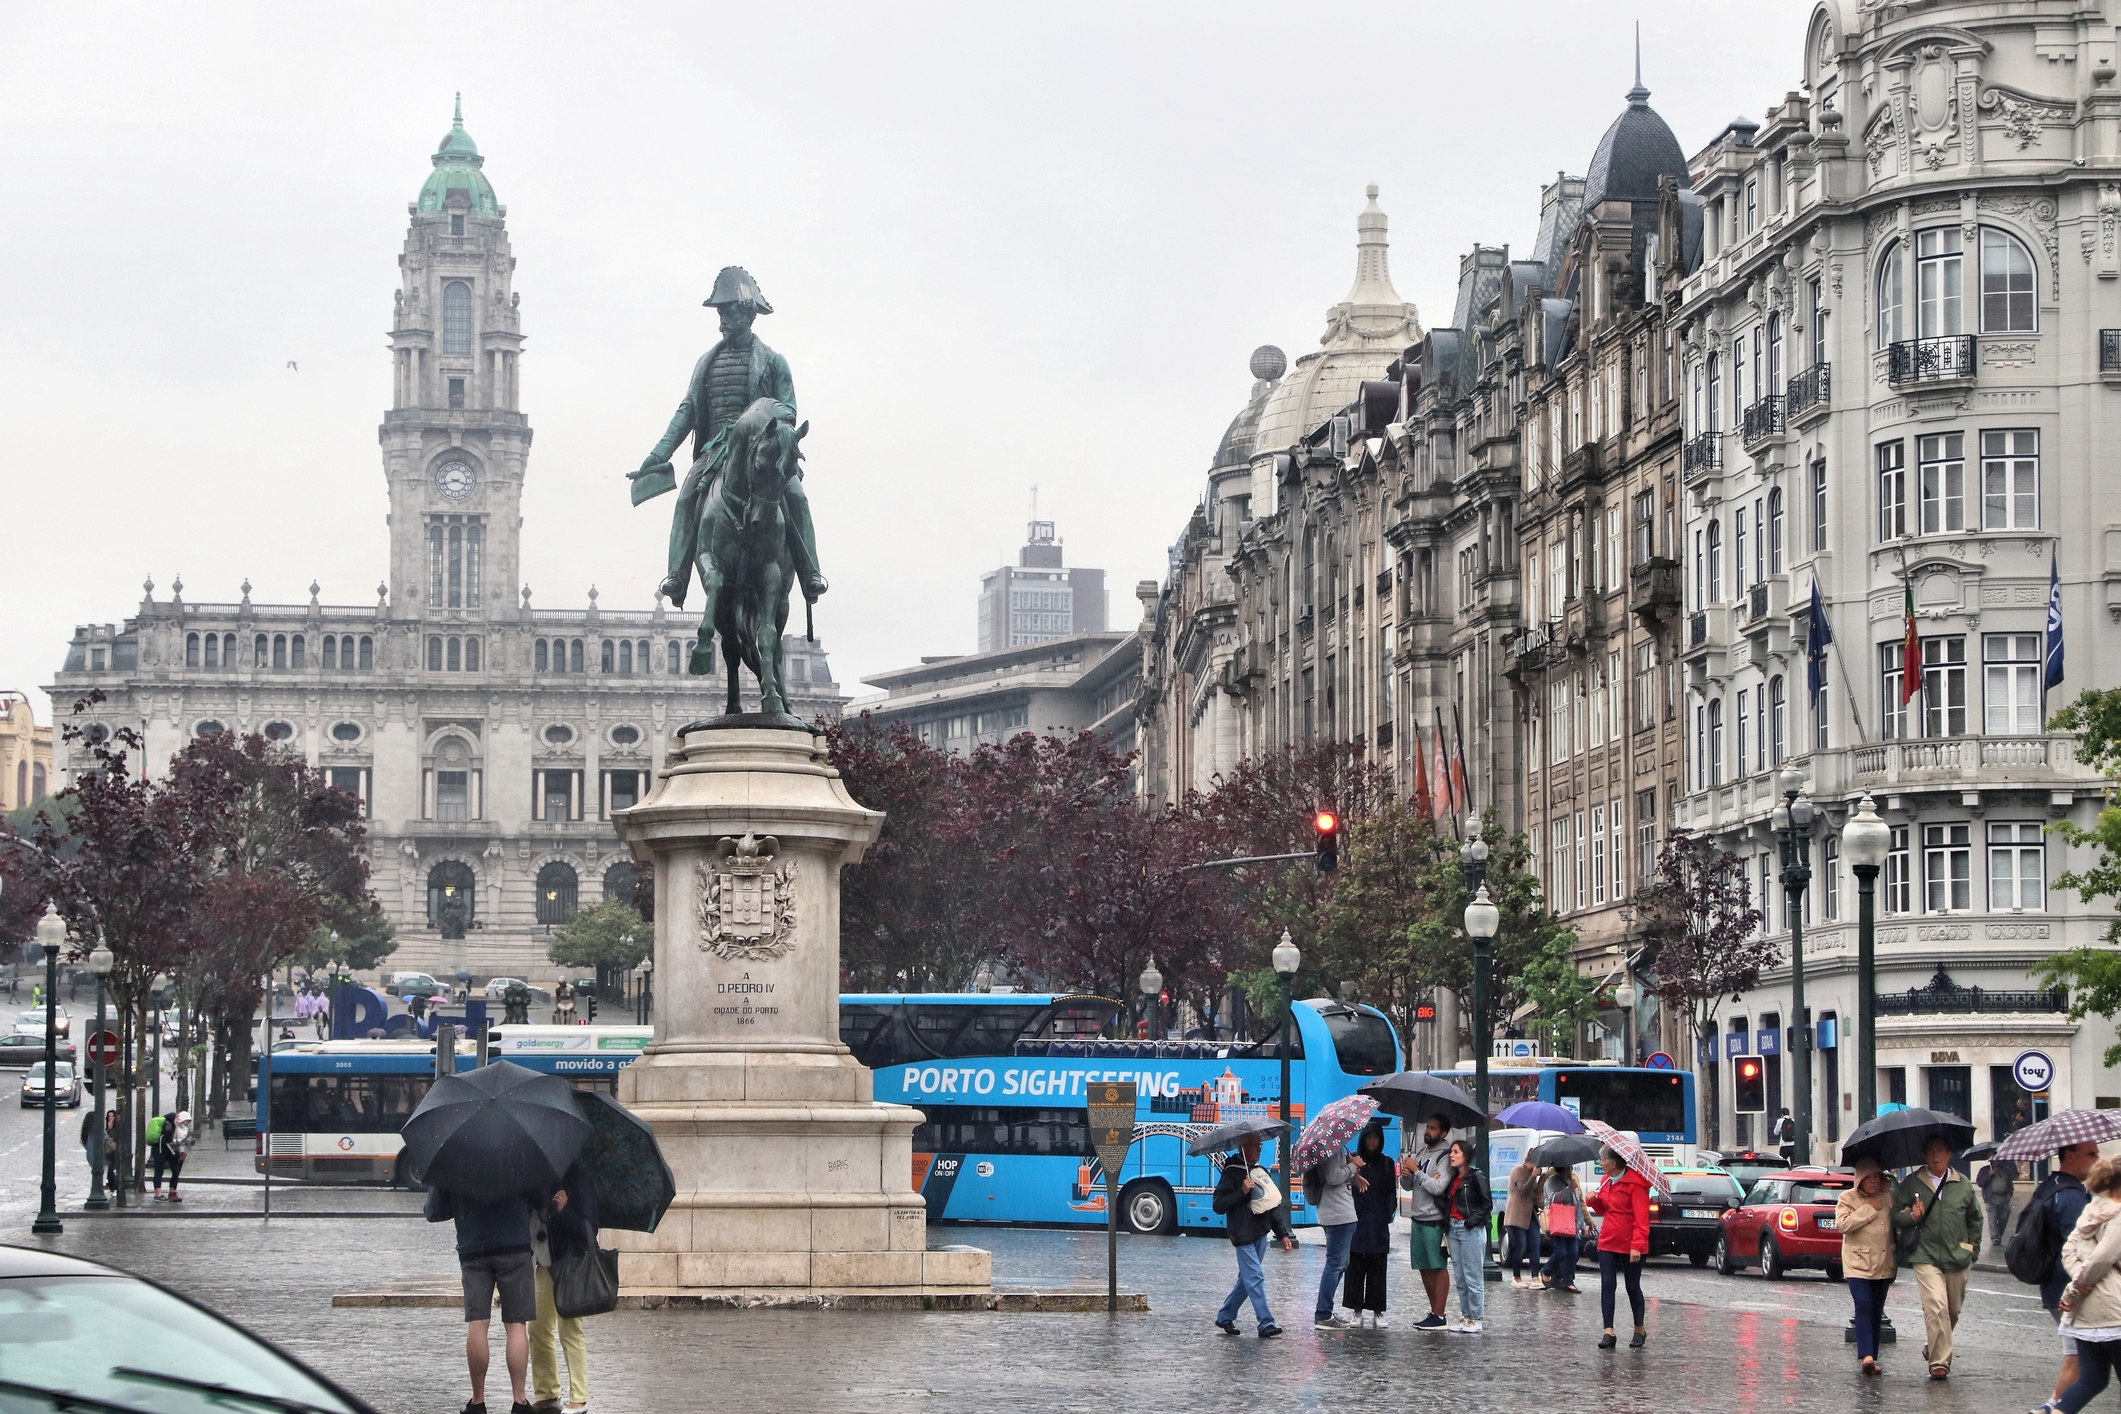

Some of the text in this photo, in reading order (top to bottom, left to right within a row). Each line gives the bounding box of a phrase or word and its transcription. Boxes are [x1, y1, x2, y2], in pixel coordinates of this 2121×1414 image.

[743, 972, 750, 980] A
[765, 983, 775, 993] IV
[743, 996, 750, 1004] A
[713, 1006, 779, 1014] CIDADE DO PORTO
[516, 1039, 565, 1049] goldenergy
[1730, 1038, 1742, 1053] BBVA
[1761, 1034, 1774, 1049] BBVA
[1930, 1051, 1960, 1063] BBVA
[555, 1058, 604, 1070] movido
[607, 1061, 615, 1070] a
[902, 1067, 996, 1095] PORTO
[937, 1160, 958, 1170] HOP
